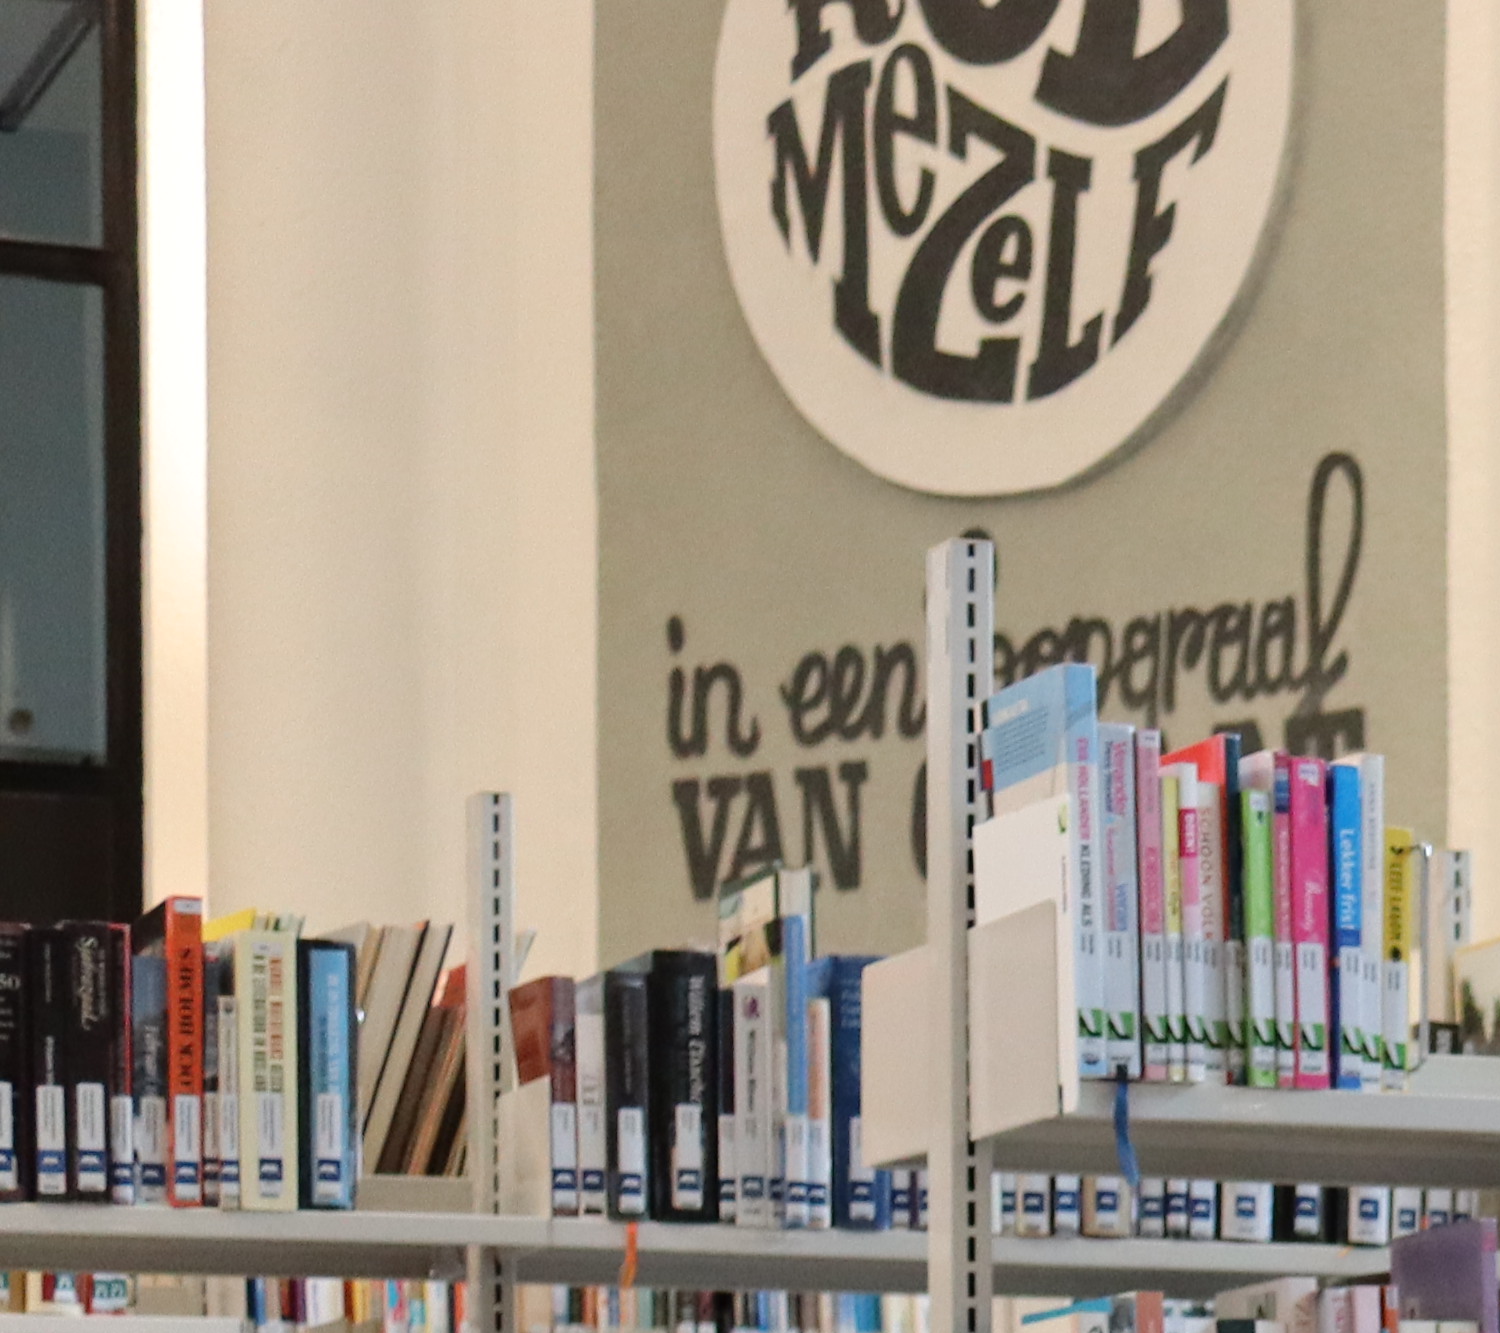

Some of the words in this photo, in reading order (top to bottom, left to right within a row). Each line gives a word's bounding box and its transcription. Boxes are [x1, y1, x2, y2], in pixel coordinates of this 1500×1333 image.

[667, 615, 760, 761] in
[671, 761, 868, 903] VAN
[1339, 828, 1356, 889] Lekker
